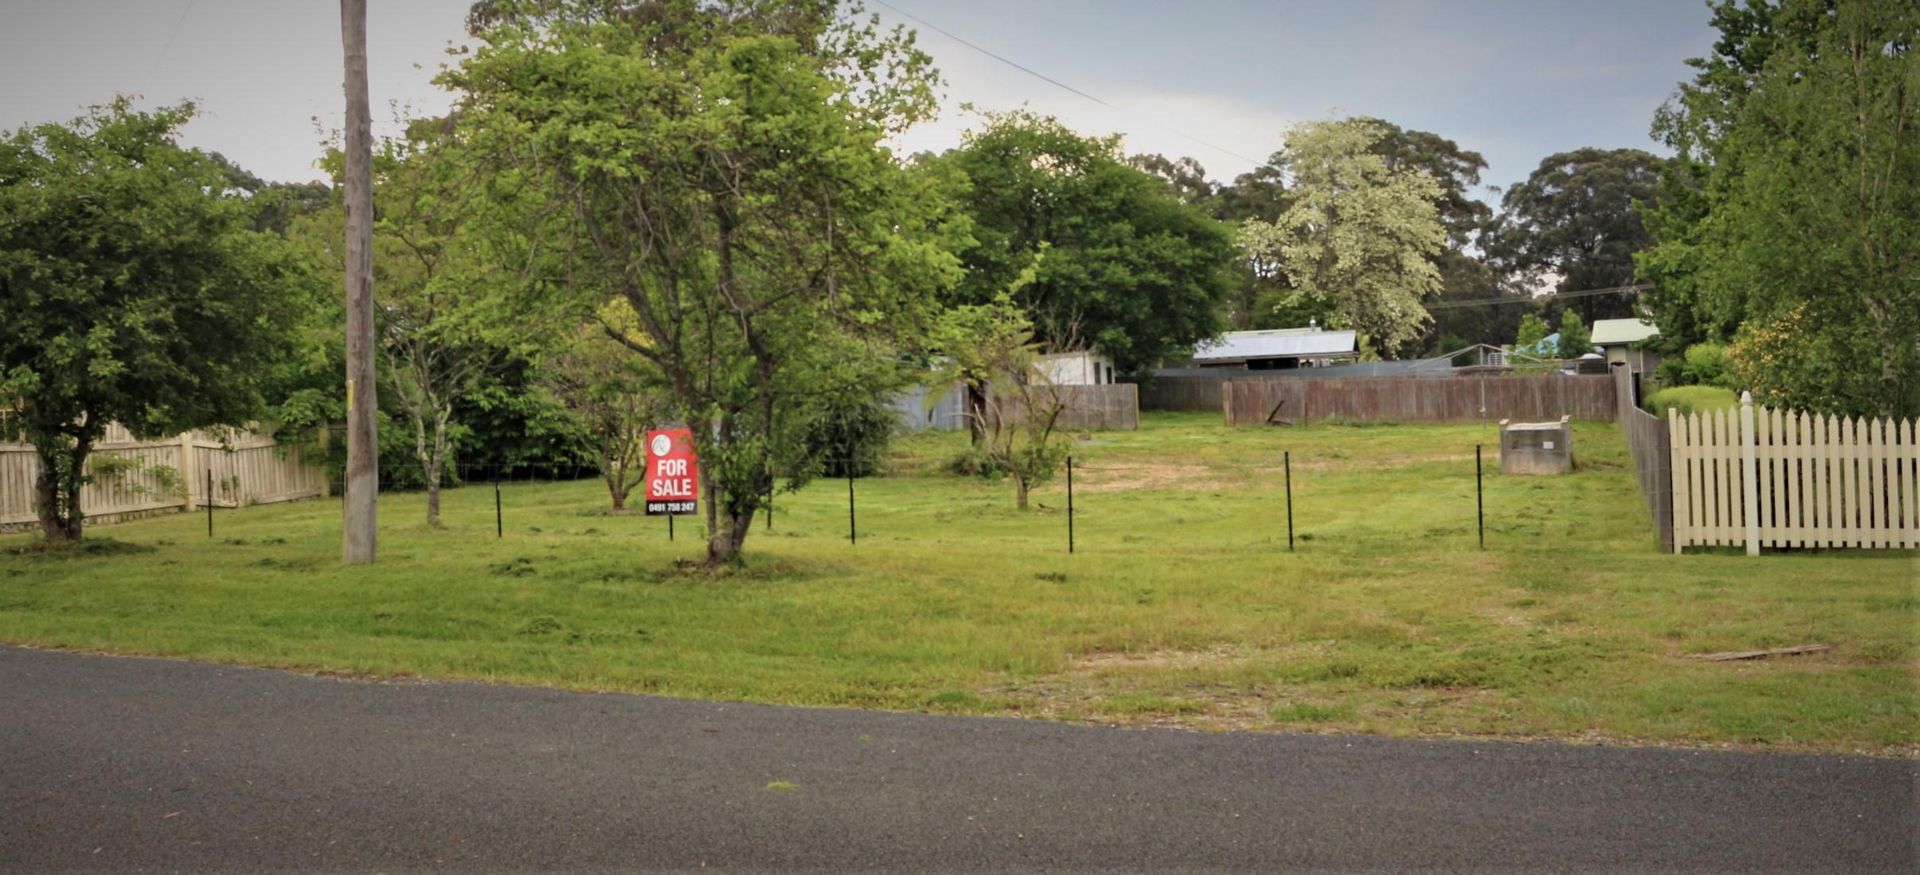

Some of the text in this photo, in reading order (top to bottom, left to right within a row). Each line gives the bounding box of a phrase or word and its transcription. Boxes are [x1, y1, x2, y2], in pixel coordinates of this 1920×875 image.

[657, 459, 687, 476] FOR
[652, 479, 692, 496] SALE
[648, 502, 666, 512] 0491
[681, 502, 695, 512] 247
